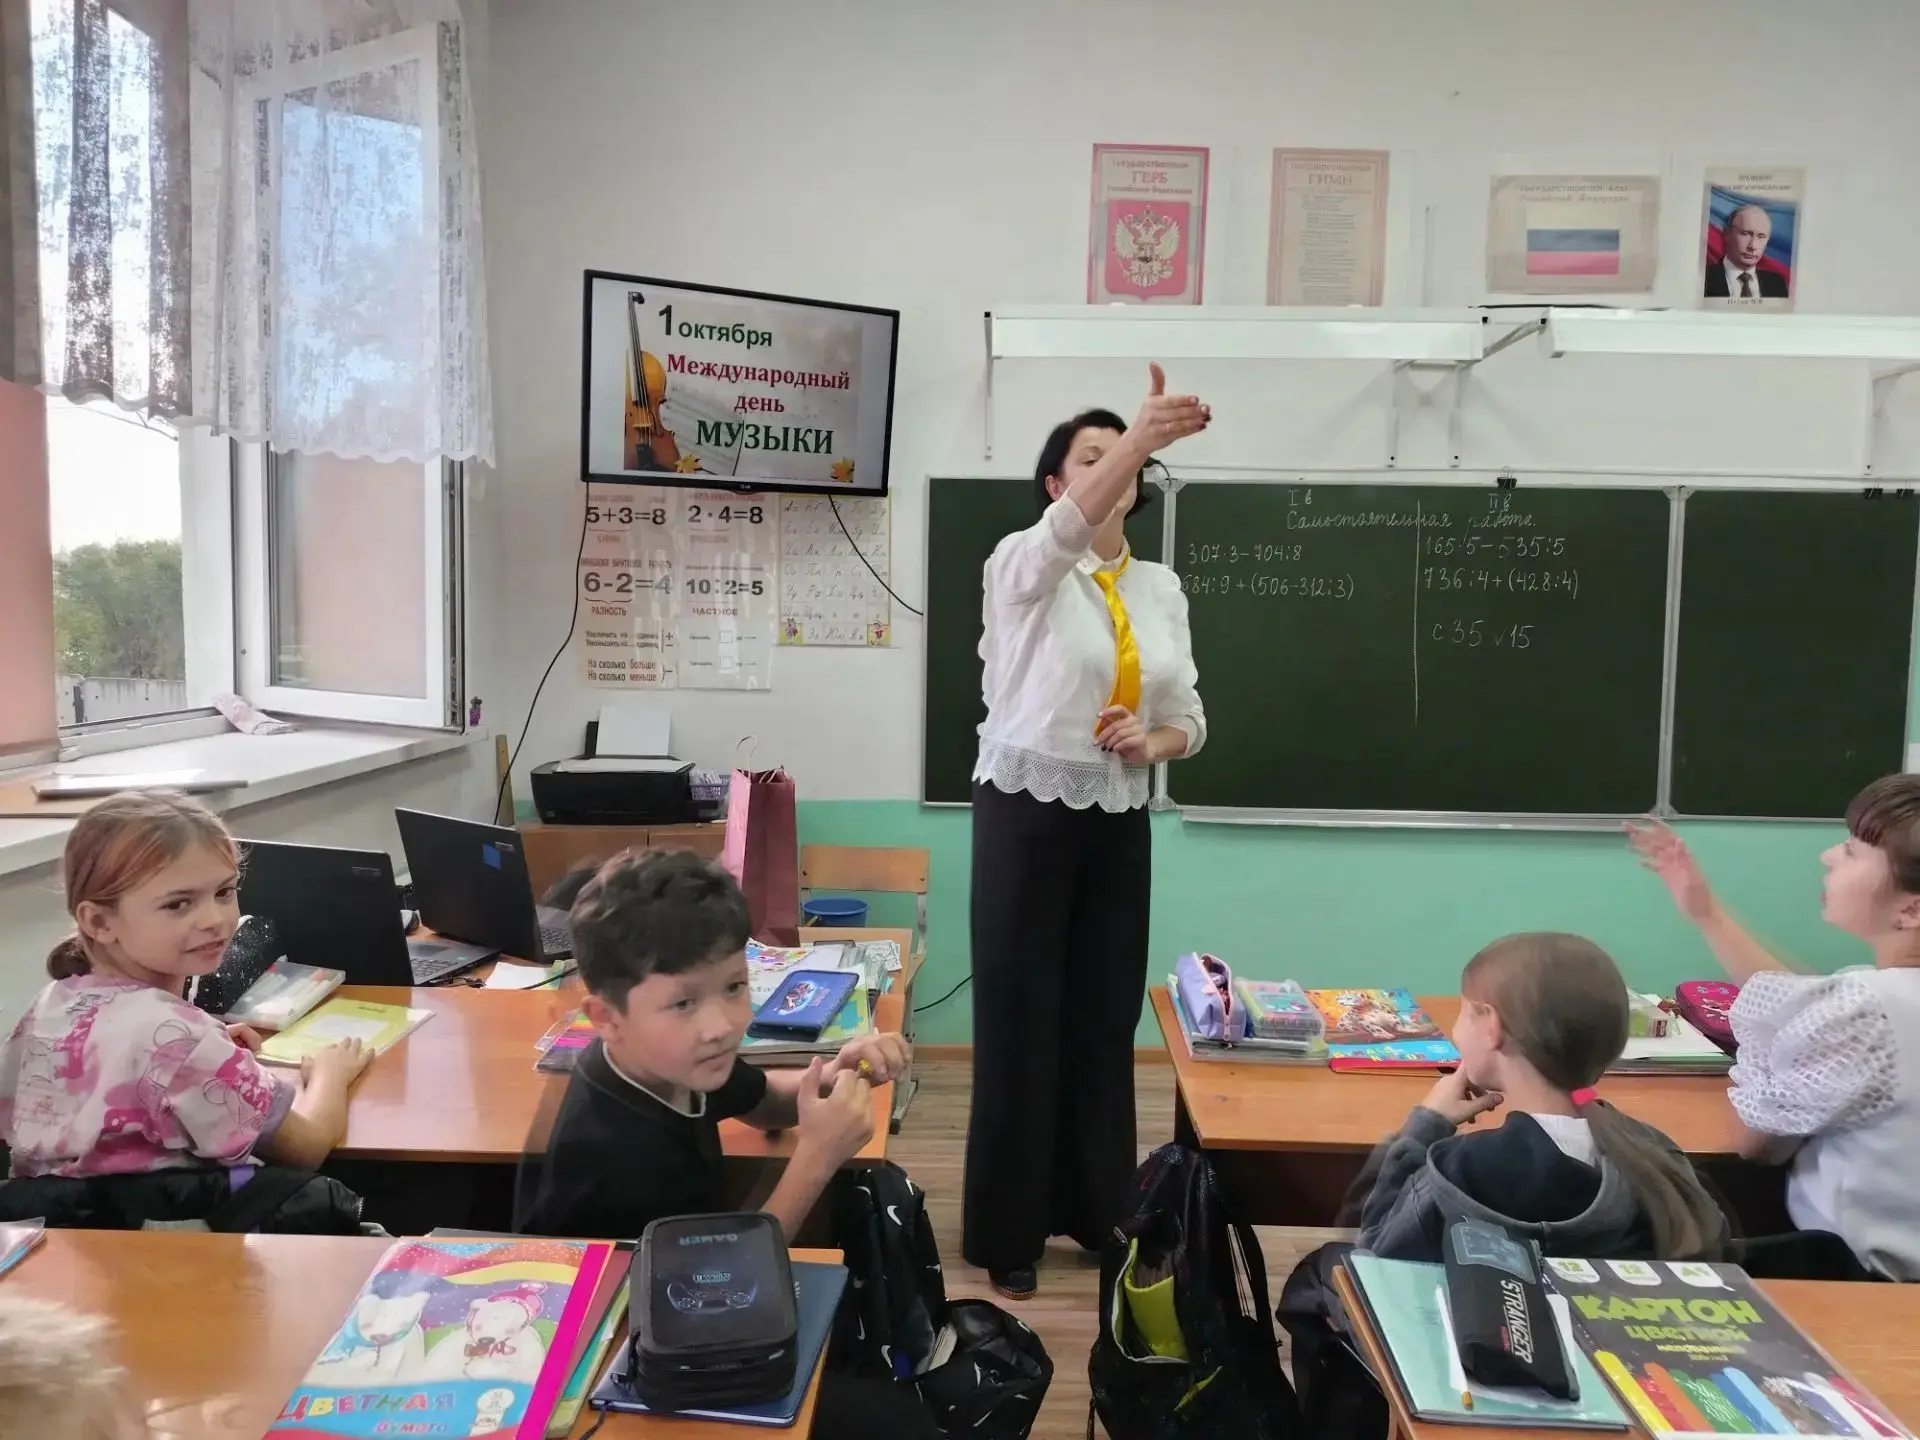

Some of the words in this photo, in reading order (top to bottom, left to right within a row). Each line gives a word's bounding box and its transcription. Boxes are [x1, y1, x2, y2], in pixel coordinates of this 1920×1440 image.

[1132, 171, 1168, 183] ГЕРБ
[658, 304, 673, 336] 1
[678, 323, 773, 349] октября
[667, 353, 850, 391] Международный
[734, 394, 785, 414] день
[696, 419, 834, 455] МУЗЫКИ
[1286, 510, 1452, 530] Самостоятельная
[591, 606, 627, 617] РАЗНОСТЬ
[692, 607, 739, 616] ЧАСТНОЕ
[587, 658, 597, 668] На
[598, 660, 626, 669] сколько
[629, 658, 656, 670] больше
[587, 670, 597, 680] На
[598, 672, 626, 682] сколько
[629, 673, 657, 682] меньше
[1572, 1294, 1765, 1324] КАРТОН
[1500, 1279, 1533, 1364] STRANGER
[276, 1391, 456, 1422] ЦВЕТНАЯ
